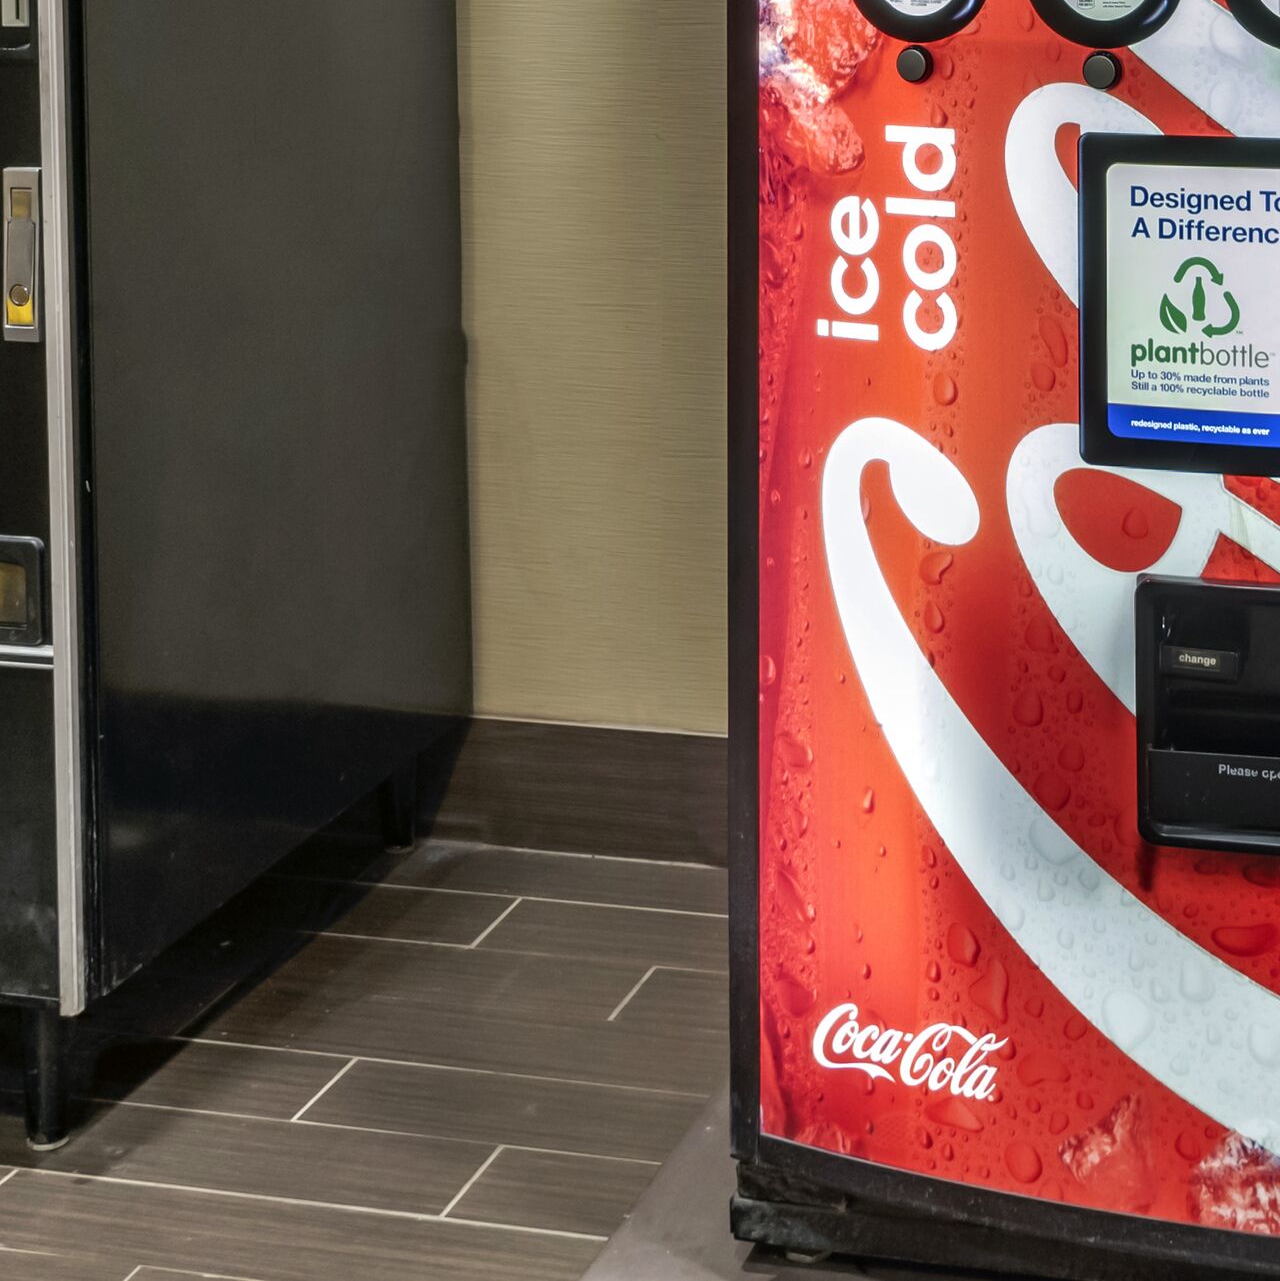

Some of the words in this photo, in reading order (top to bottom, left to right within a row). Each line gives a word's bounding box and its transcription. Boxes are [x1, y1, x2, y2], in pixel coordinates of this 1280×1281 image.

[1130, 185, 1251, 214] Designed
[885, 125, 958, 351] cold
[1131, 217, 1150, 238] A
[816, 195, 880, 341] ice
[1131, 339, 1269, 368] plantbottle
[1131, 369, 1145, 380] Up
[1148, 371, 1158, 380] to
[1160, 371, 1180, 381] 30%
[1183, 373, 1211, 383] made
[1213, 374, 1237, 384] from
[1239, 376, 1270, 386] plants
[1131, 380, 1149, 391] Still
[1160, 383, 1184, 393] 100%
[1186, 385, 1237, 396] recyclable
[1239, 388, 1270, 398] bottle
[1131, 419, 1172, 430] redesigned
[1173, 421, 1200, 432] plastic,
[1201, 424, 1240, 434] recyclable
[1242, 427, 1251, 435] as
[1253, 428, 1270, 436] ever
[1178, 653, 1217, 666] change
[1218, 764, 1258, 778] Please
[812, 1003, 1009, 1102] Coca-Cola
